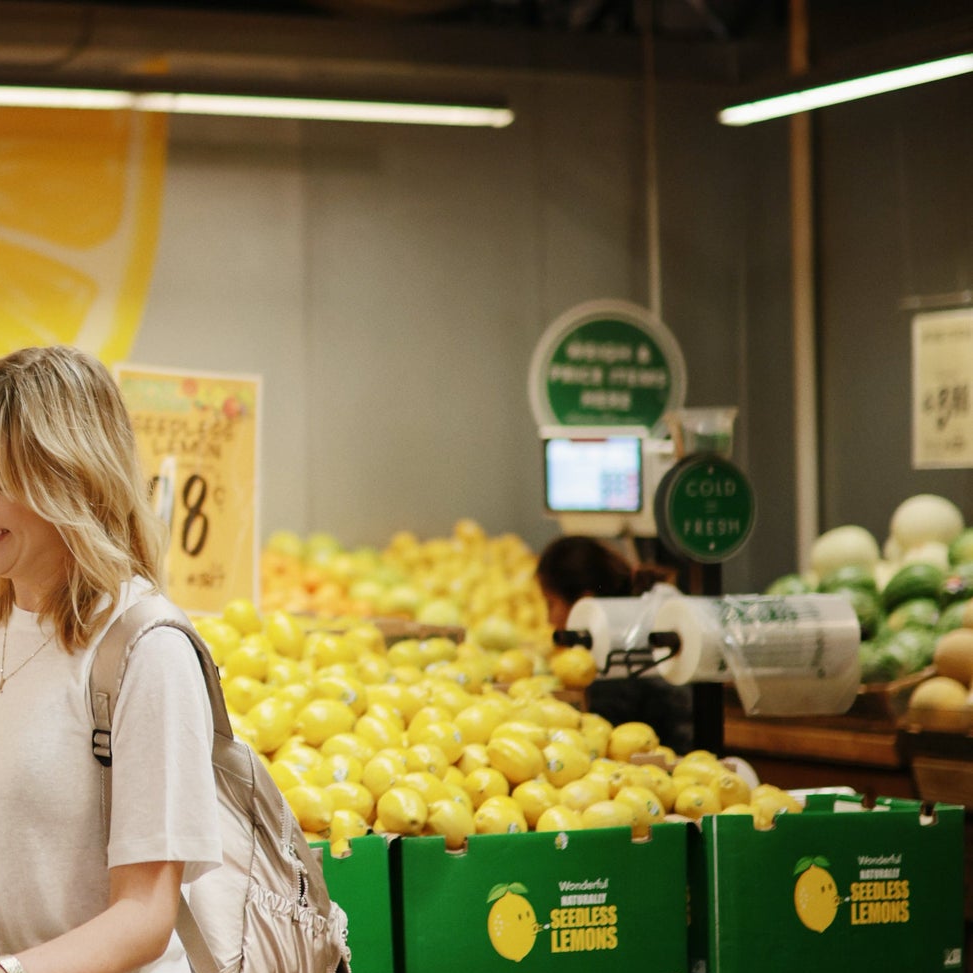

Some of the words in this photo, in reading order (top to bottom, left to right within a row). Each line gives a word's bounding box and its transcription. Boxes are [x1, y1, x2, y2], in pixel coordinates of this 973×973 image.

[685, 479, 736, 498] COLD
[683, 518, 740, 537] FRESH
[858, 853, 902, 866] Wonderful
[558, 878, 609, 891] Wonderful
[850, 880, 910, 902] SEEDLESS
[549, 905, 618, 930] SEEDLESS
[851, 899, 910, 925] LEMONS
[550, 926, 618, 953] LEMONS
